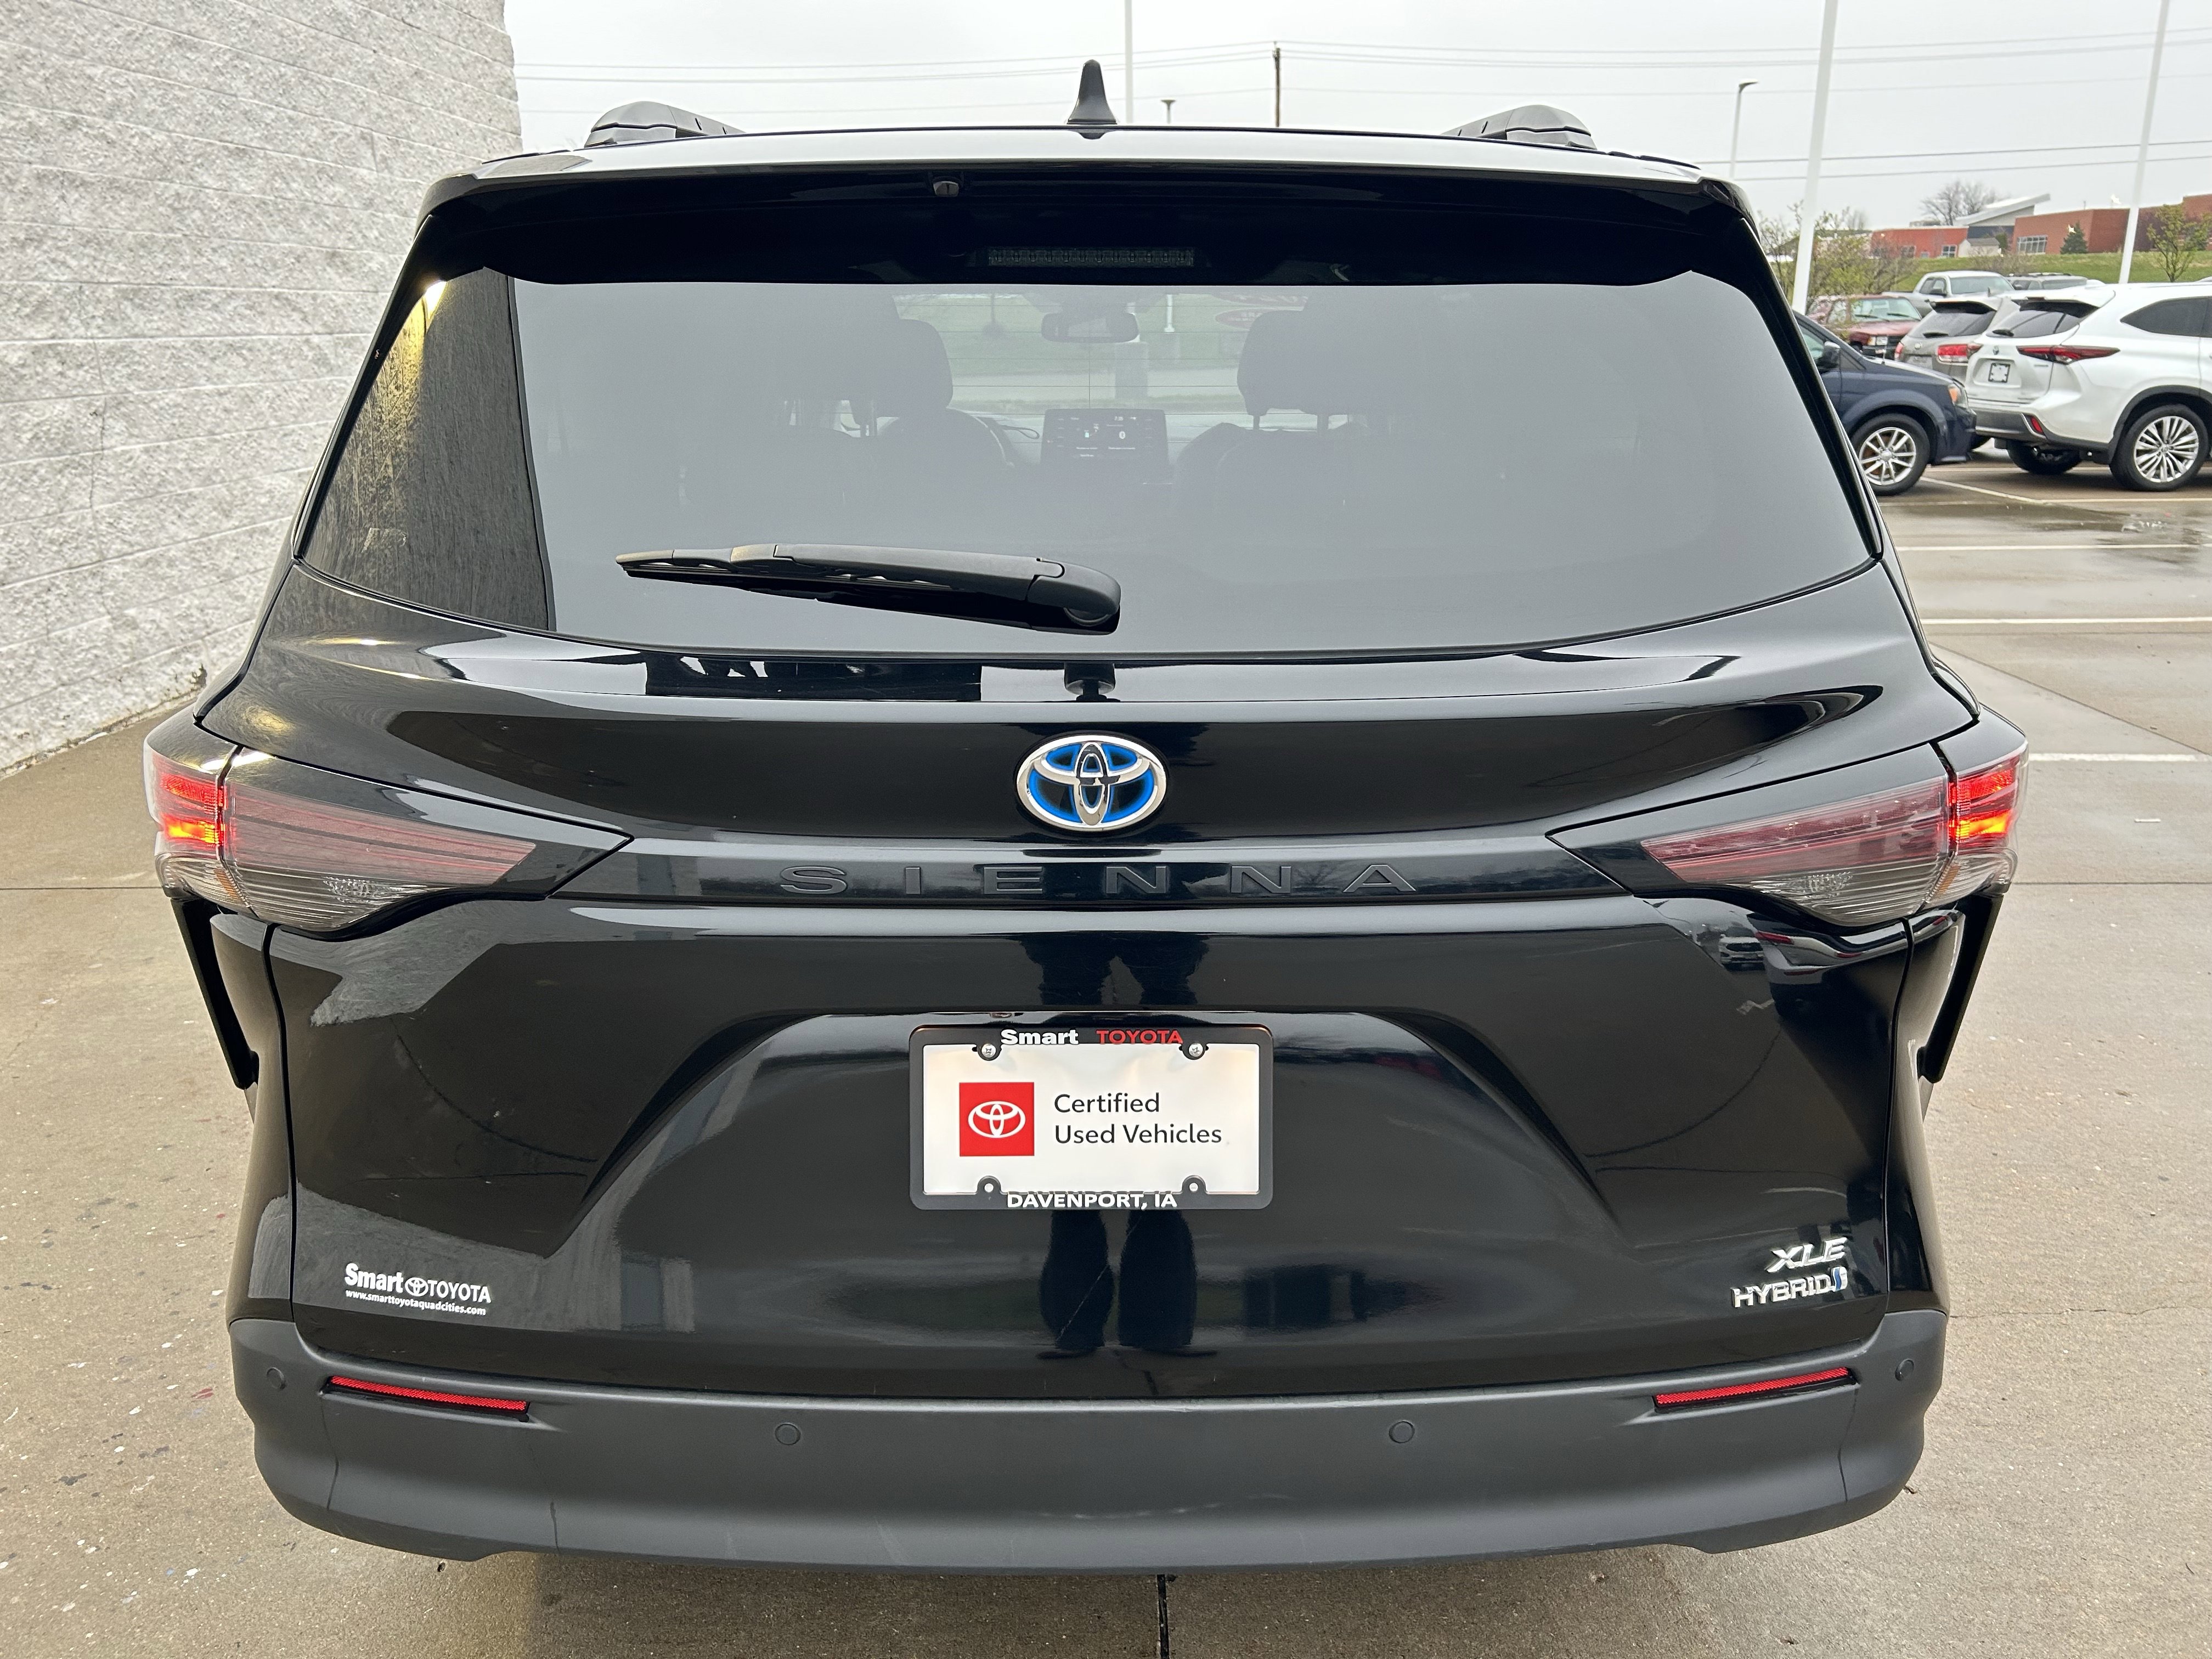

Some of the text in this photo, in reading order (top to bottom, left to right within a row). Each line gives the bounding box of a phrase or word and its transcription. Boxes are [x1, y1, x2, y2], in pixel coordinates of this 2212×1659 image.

[780, 864, 1417, 896] SIENNA
[1000, 1029, 1183, 1045] Smart TOYOTA
[1054, 1092, 1159, 1113] Certified
[1054, 1123, 1222, 1144] Used Vehicles
[1006, 1193, 1177, 1210] DAVENPORT, IA
[1767, 1237, 1848, 1273] XLE
[345, 1262, 492, 1303] Smart TOYOTA
[1732, 1274, 1832, 1308] HYBRID
[346, 1290, 486, 1316] www.smarttoyotaquadcities.com
